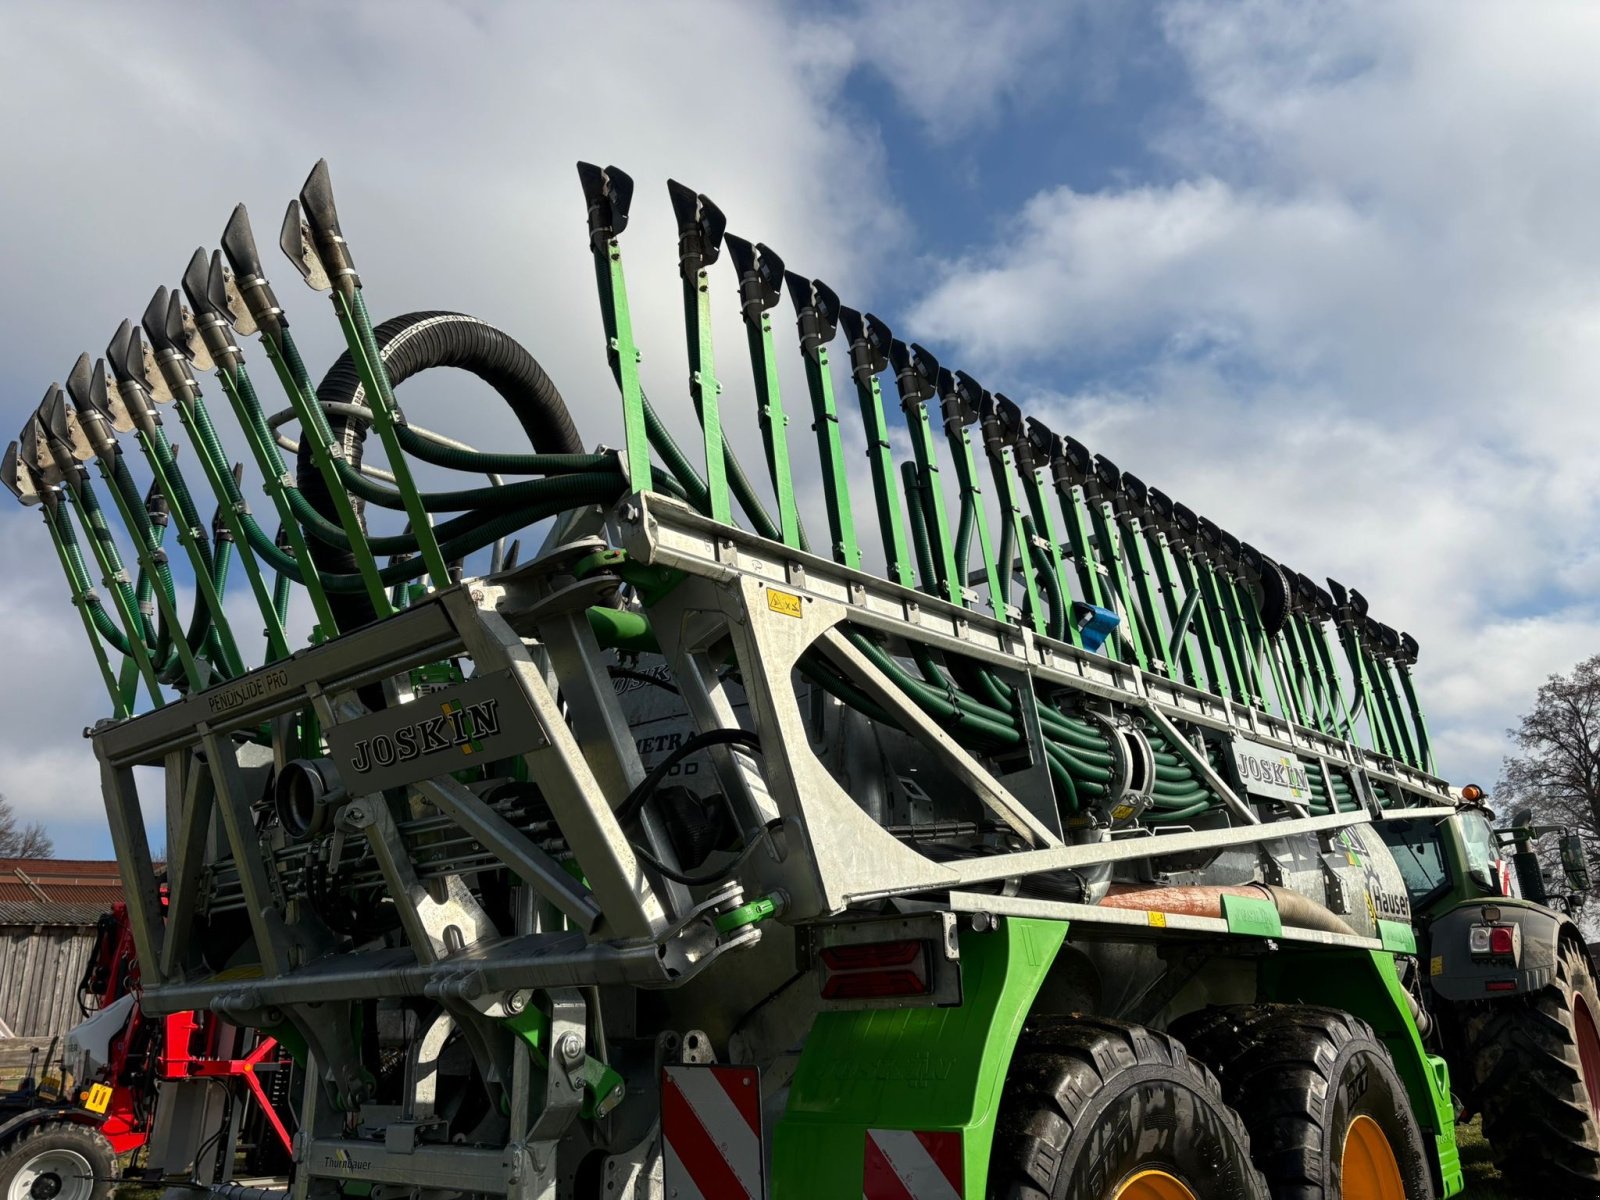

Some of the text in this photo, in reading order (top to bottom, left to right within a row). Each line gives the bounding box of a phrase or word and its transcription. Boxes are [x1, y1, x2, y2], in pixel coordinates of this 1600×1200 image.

[265, 670, 288, 692] PRO
[351, 698, 501, 774] JOSKIN
[1237, 753, 1309, 792] JOSKIN
[1371, 884, 1410, 917] Hauser
[324, 1156, 372, 1171] Thurnbauer
